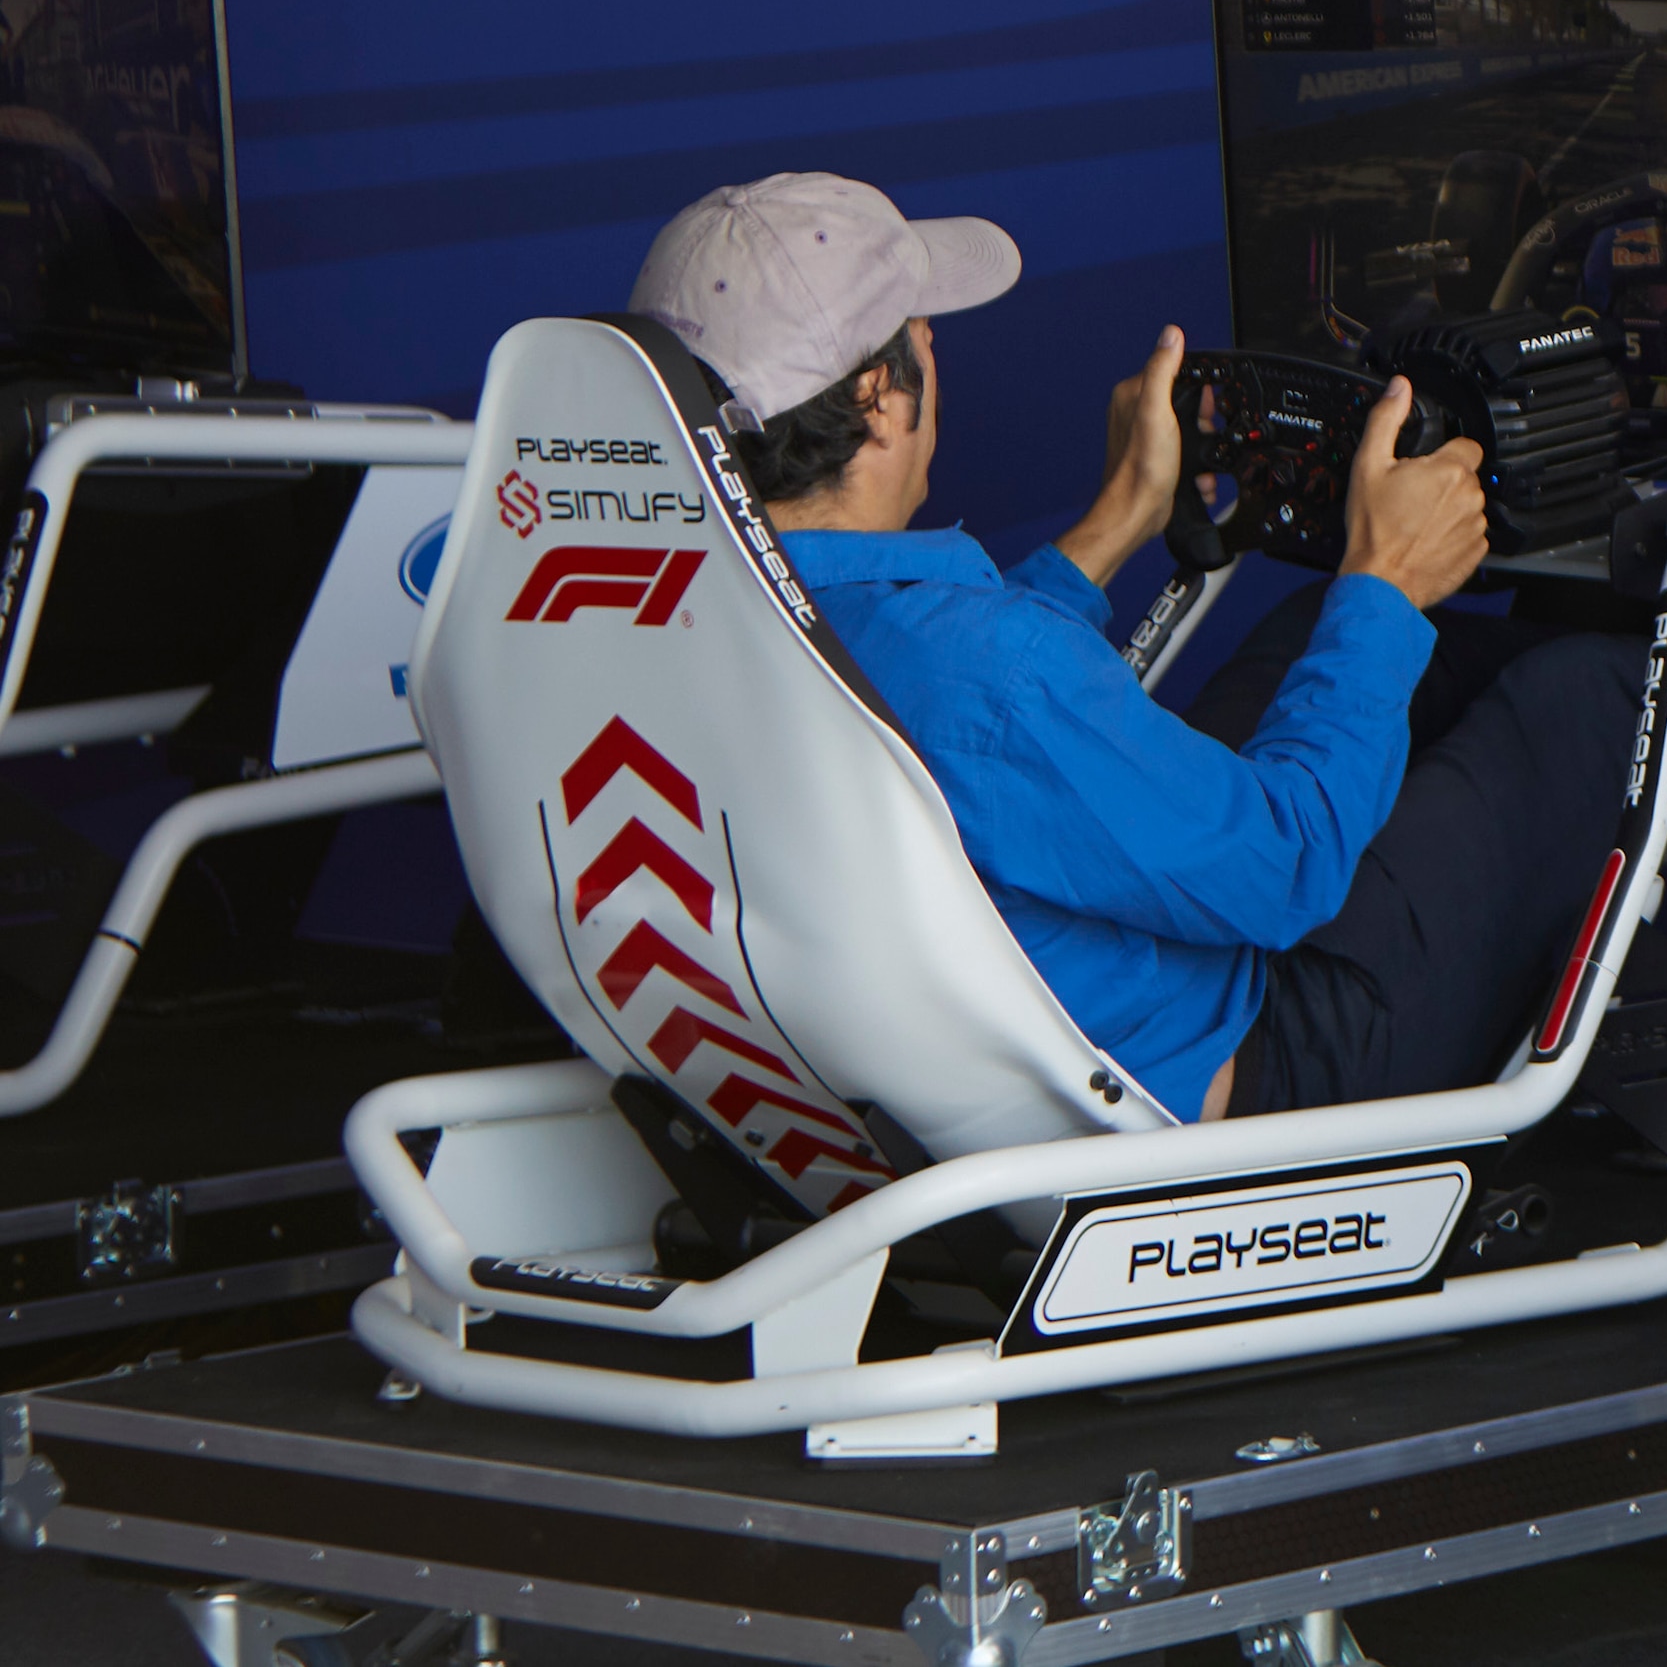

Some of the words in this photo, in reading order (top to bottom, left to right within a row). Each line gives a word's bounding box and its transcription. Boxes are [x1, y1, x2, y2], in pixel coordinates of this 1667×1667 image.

[1520, 326, 1594, 352] FANATEC
[1625, 332, 1641, 358] 5
[1268, 411, 1324, 431] FANATEC
